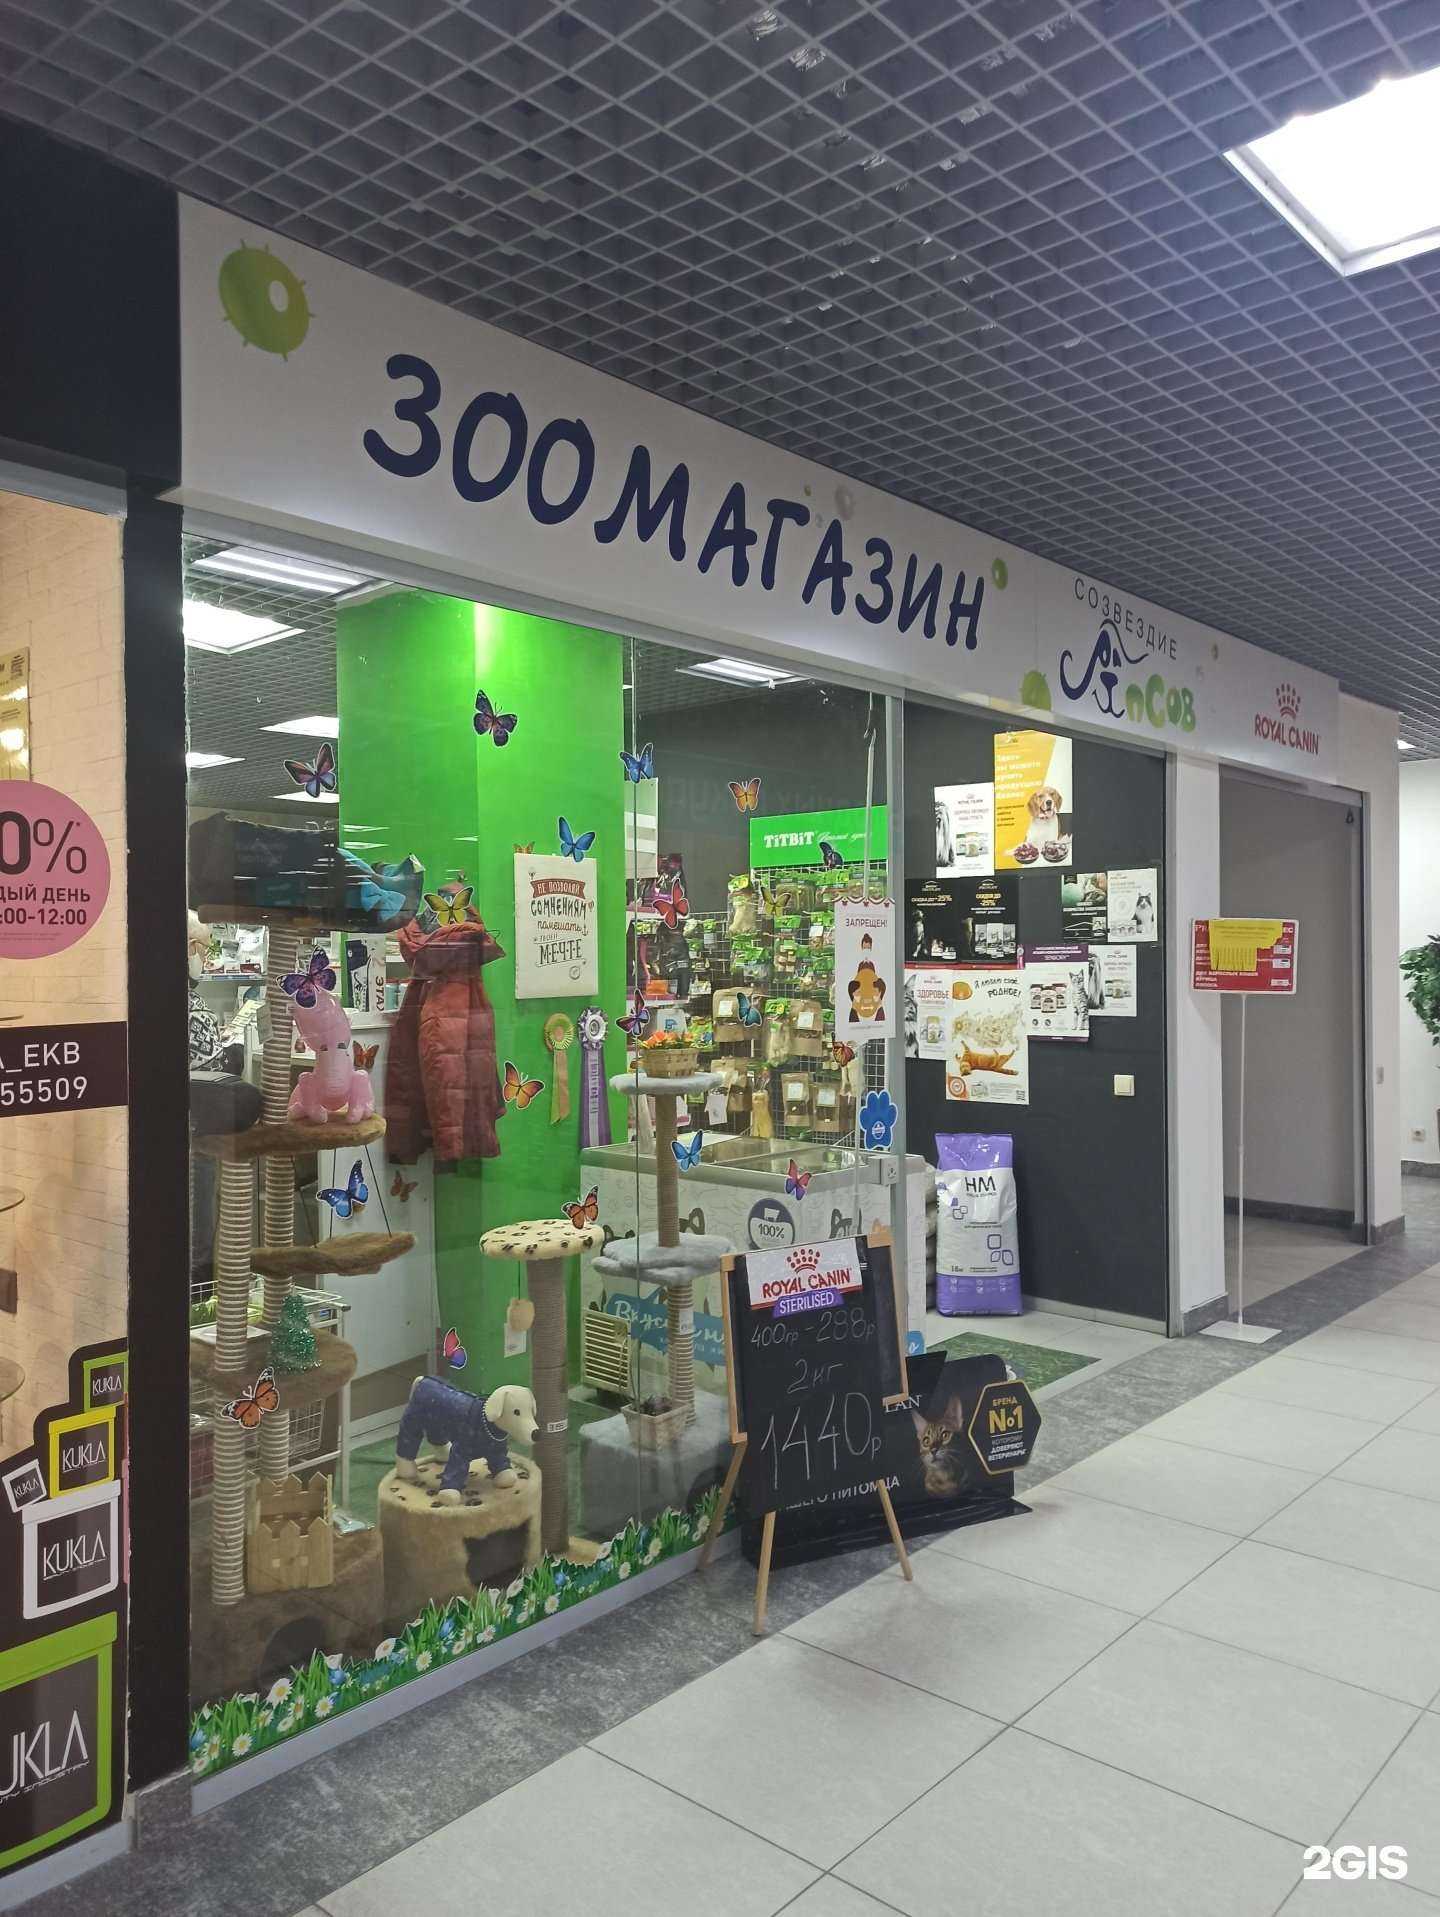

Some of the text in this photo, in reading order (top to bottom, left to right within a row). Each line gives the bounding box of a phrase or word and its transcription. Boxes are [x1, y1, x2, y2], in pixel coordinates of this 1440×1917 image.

[363, 354, 985, 651] ЗООМАГАЗИН
[1074, 578, 1177, 660] СОЗВЕЗДИЕ
[1254, 713, 1319, 755] ROYAL CANIN
[42, 887, 91, 904] ДЕНЬ
[530, 896, 586, 920] СОМНЕНИЯМ
[846, 917, 888, 929] ЗАПРЕЩЕН!
[0, 1042, 80, 1073] _EKB
[0, 1076, 88, 1106] 55509
[758, 1222, 785, 1240] 100%
[763, 1269, 852, 1298] ROYAL CANIN
[780, 1292, 834, 1314] STERILISED
[92, 1375, 122, 1396] KUKLA
[885, 1394, 922, 1413] LAN
[62, 1440, 107, 1471] KUKLA
[14, 1477, 40, 1497] KUKLA
[43, 1530, 106, 1577] KUKLA
